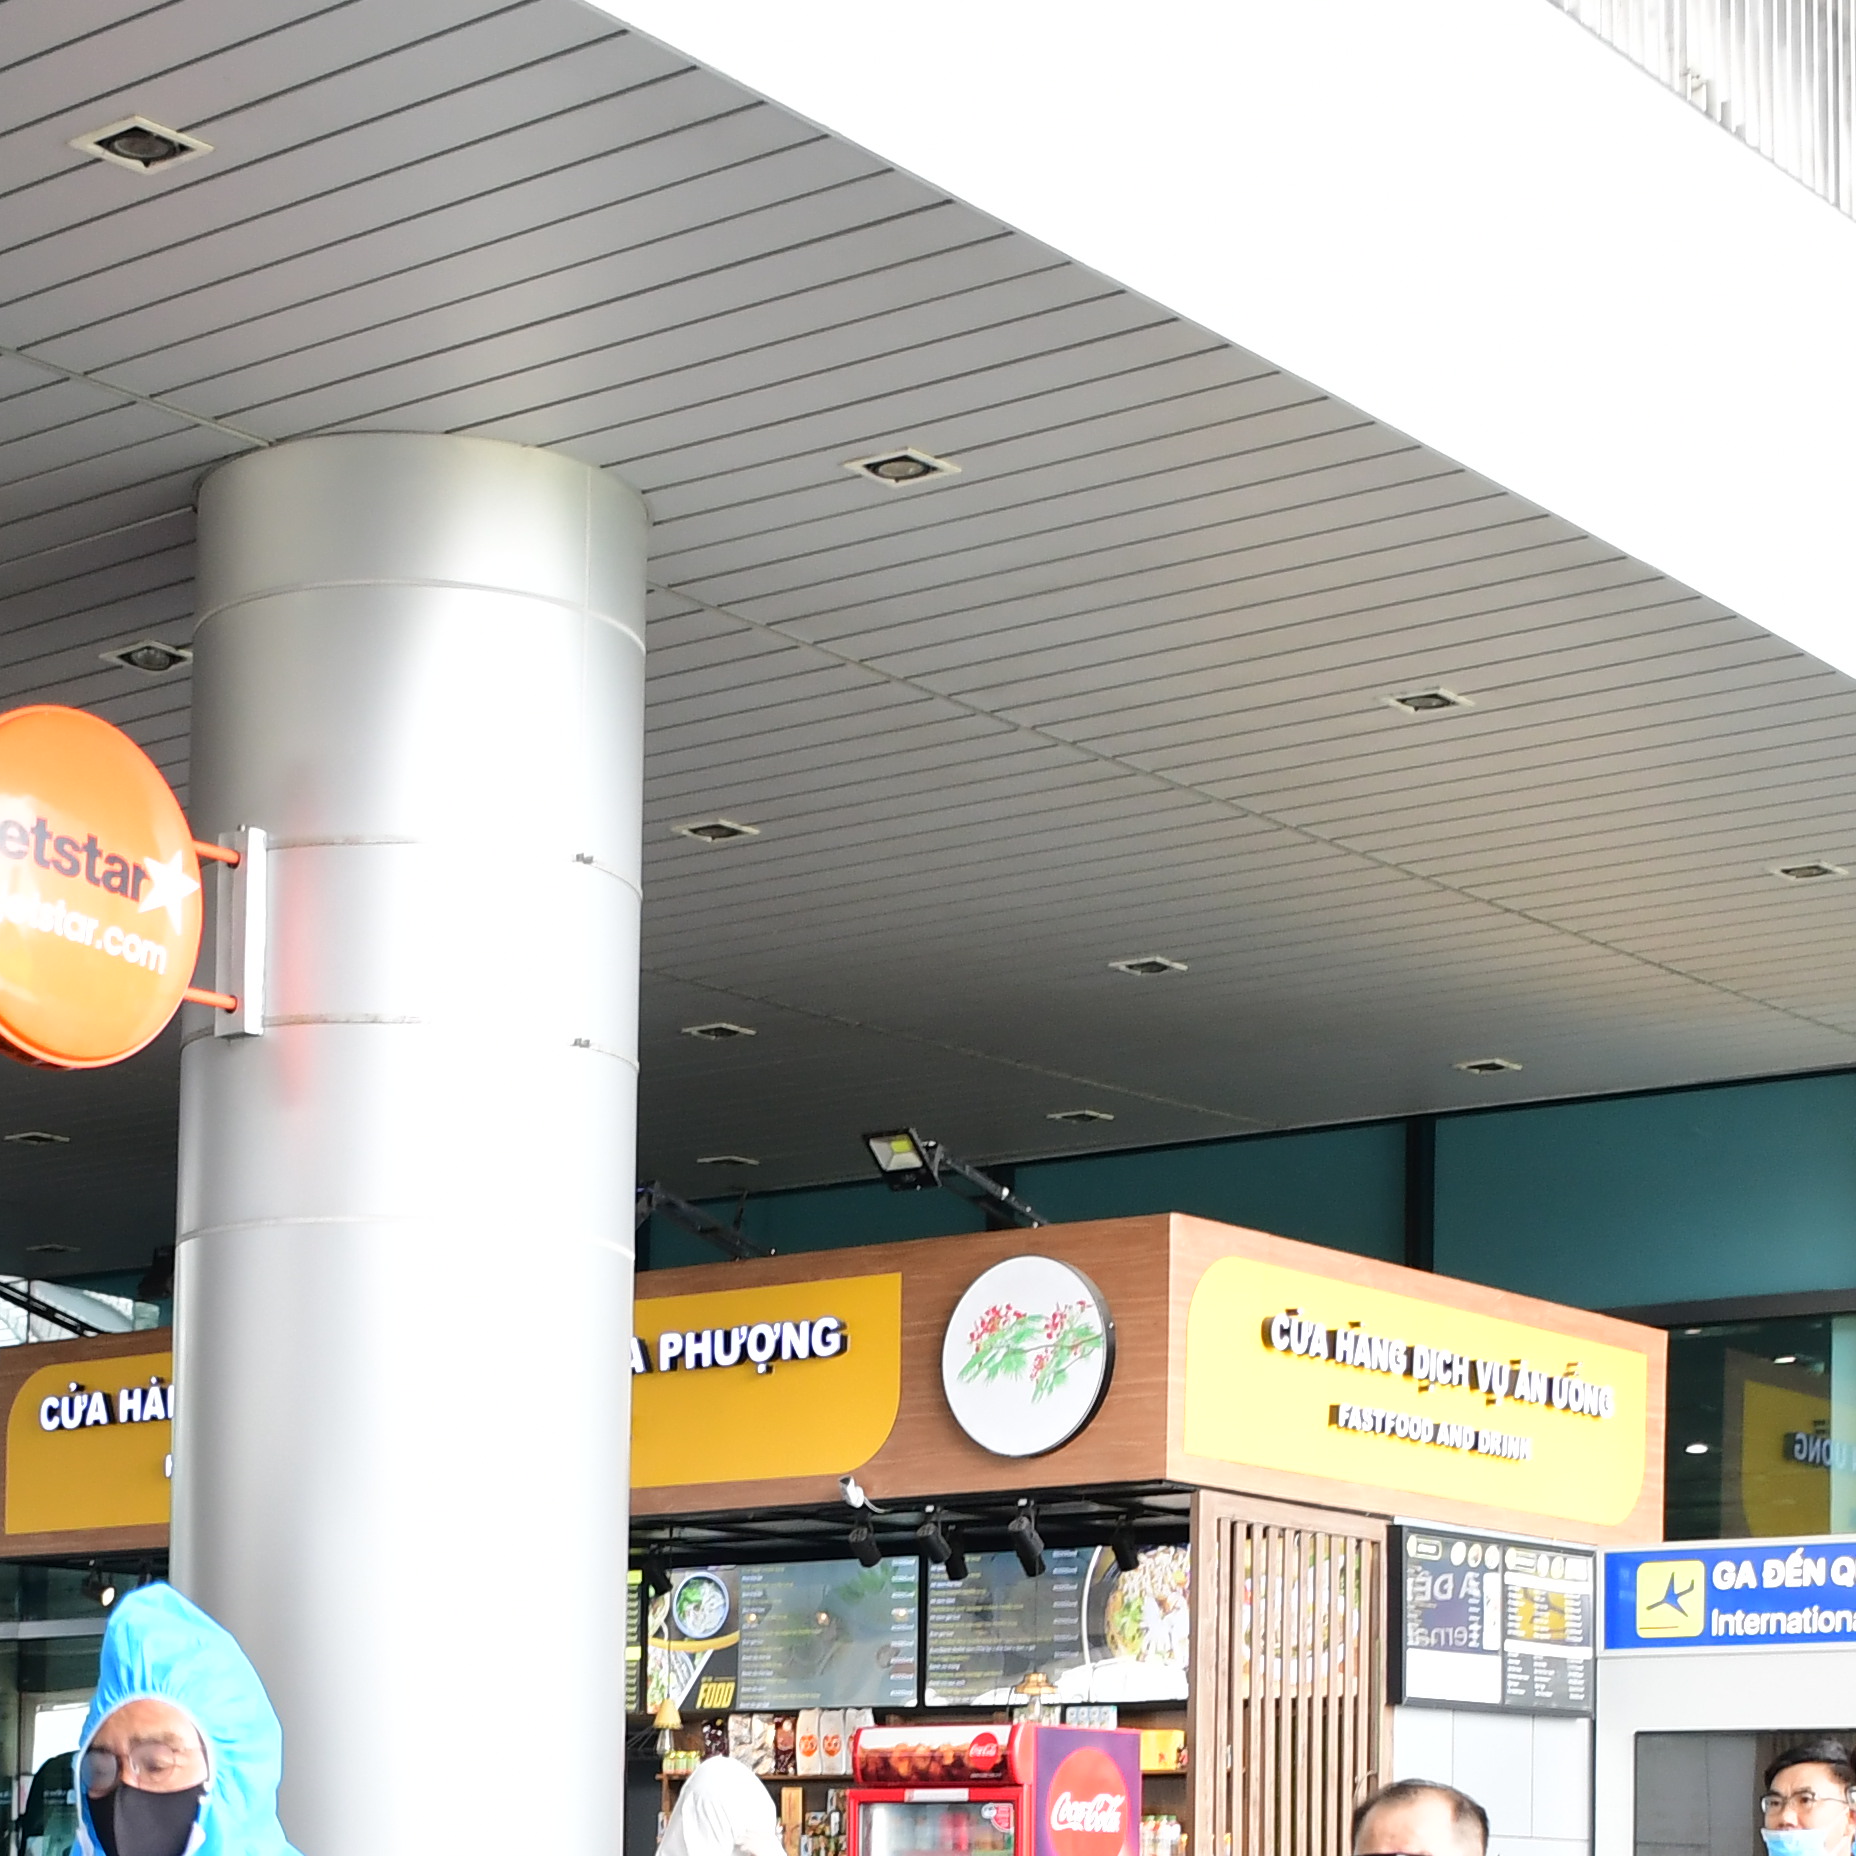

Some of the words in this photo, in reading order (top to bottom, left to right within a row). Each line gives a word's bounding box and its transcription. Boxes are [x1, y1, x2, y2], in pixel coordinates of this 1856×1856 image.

[39, 1381, 110, 1431] CỬA
[658, 1316, 843, 1374] PHƯỢNG
[1338, 1403, 1434, 1444] FASTFOOD
[1436, 1423, 1477, 1452] AND
[1477, 1430, 1532, 1460] DRINK
[1712, 1555, 1756, 1592] GA
[1762, 1547, 1826, 1589] ĐẾN
[696, 1681, 735, 1709] FOOD
[1049, 1791, 1126, 1833] Coca-Cola
